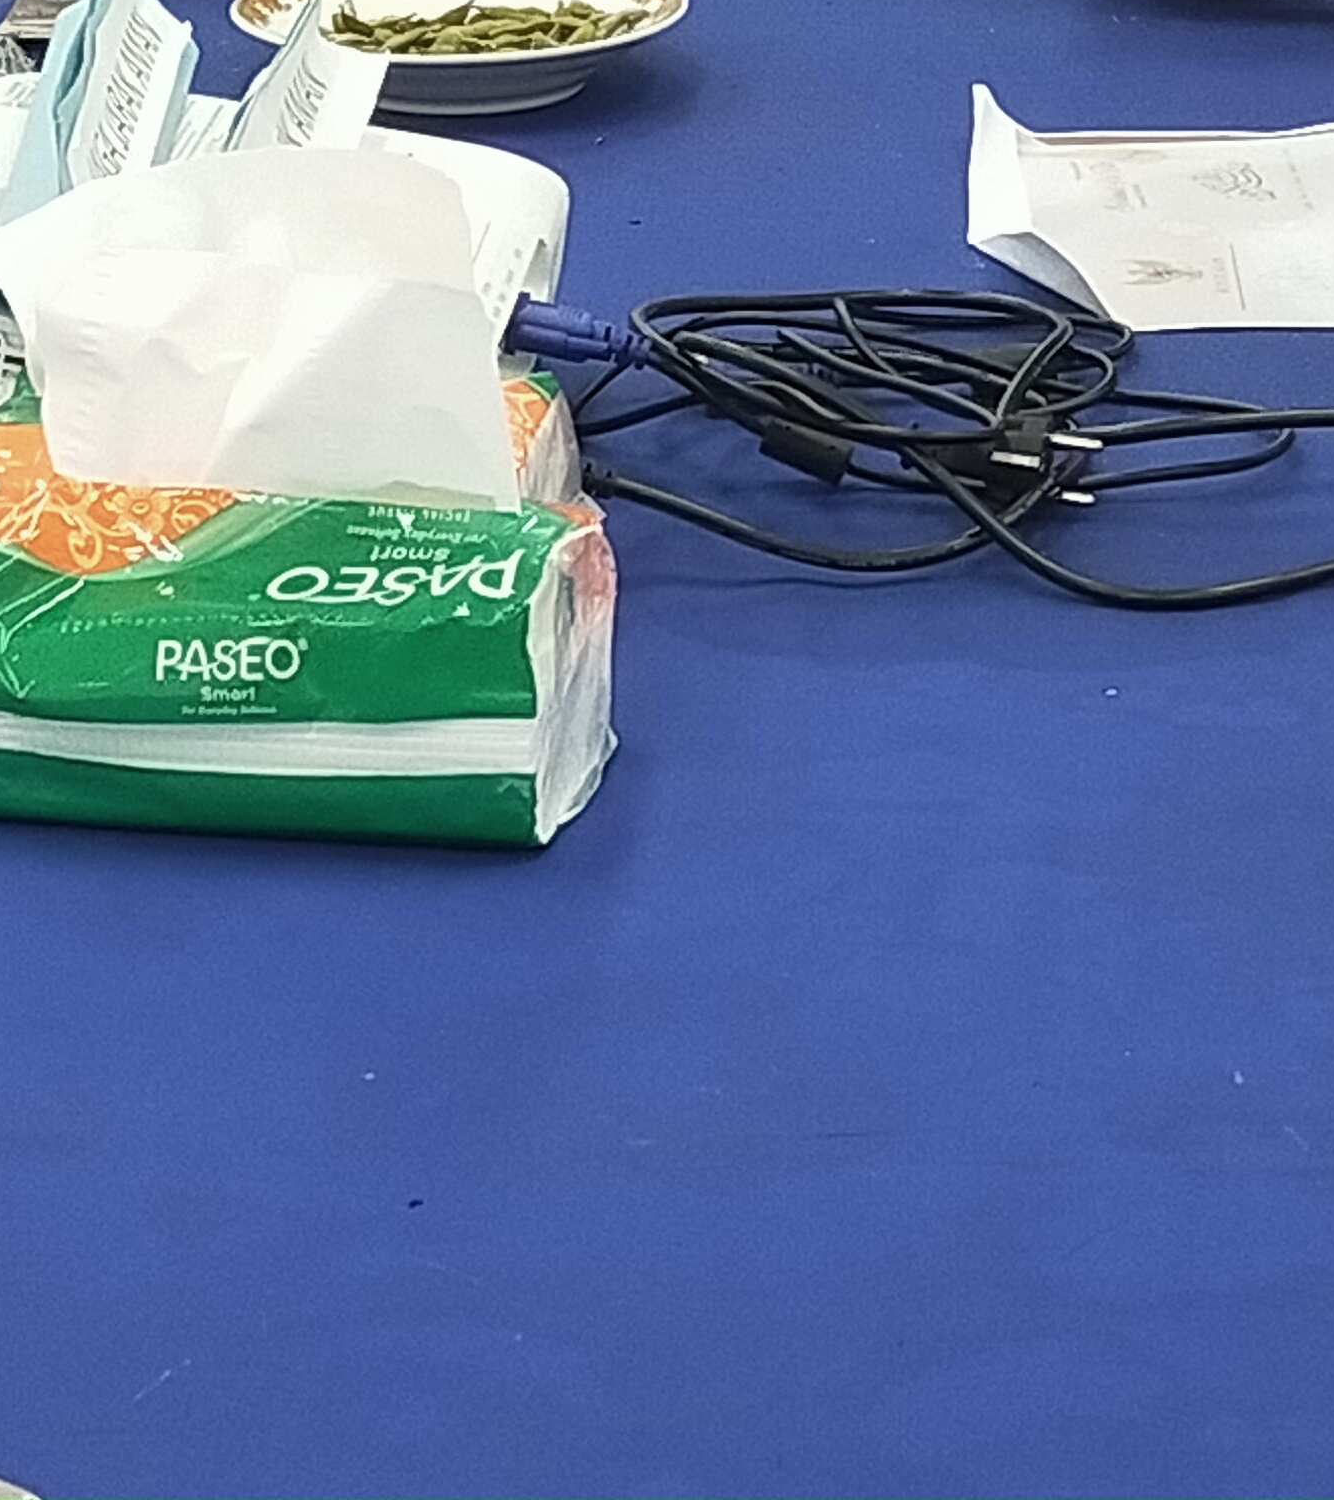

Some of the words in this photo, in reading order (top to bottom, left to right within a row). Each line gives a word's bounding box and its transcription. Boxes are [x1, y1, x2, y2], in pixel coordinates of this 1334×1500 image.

[370, 545, 451, 562] Smart
[266, 549, 526, 606] PASEO
[156, 636, 301, 682] PASEO
[200, 686, 256, 702] Smart
